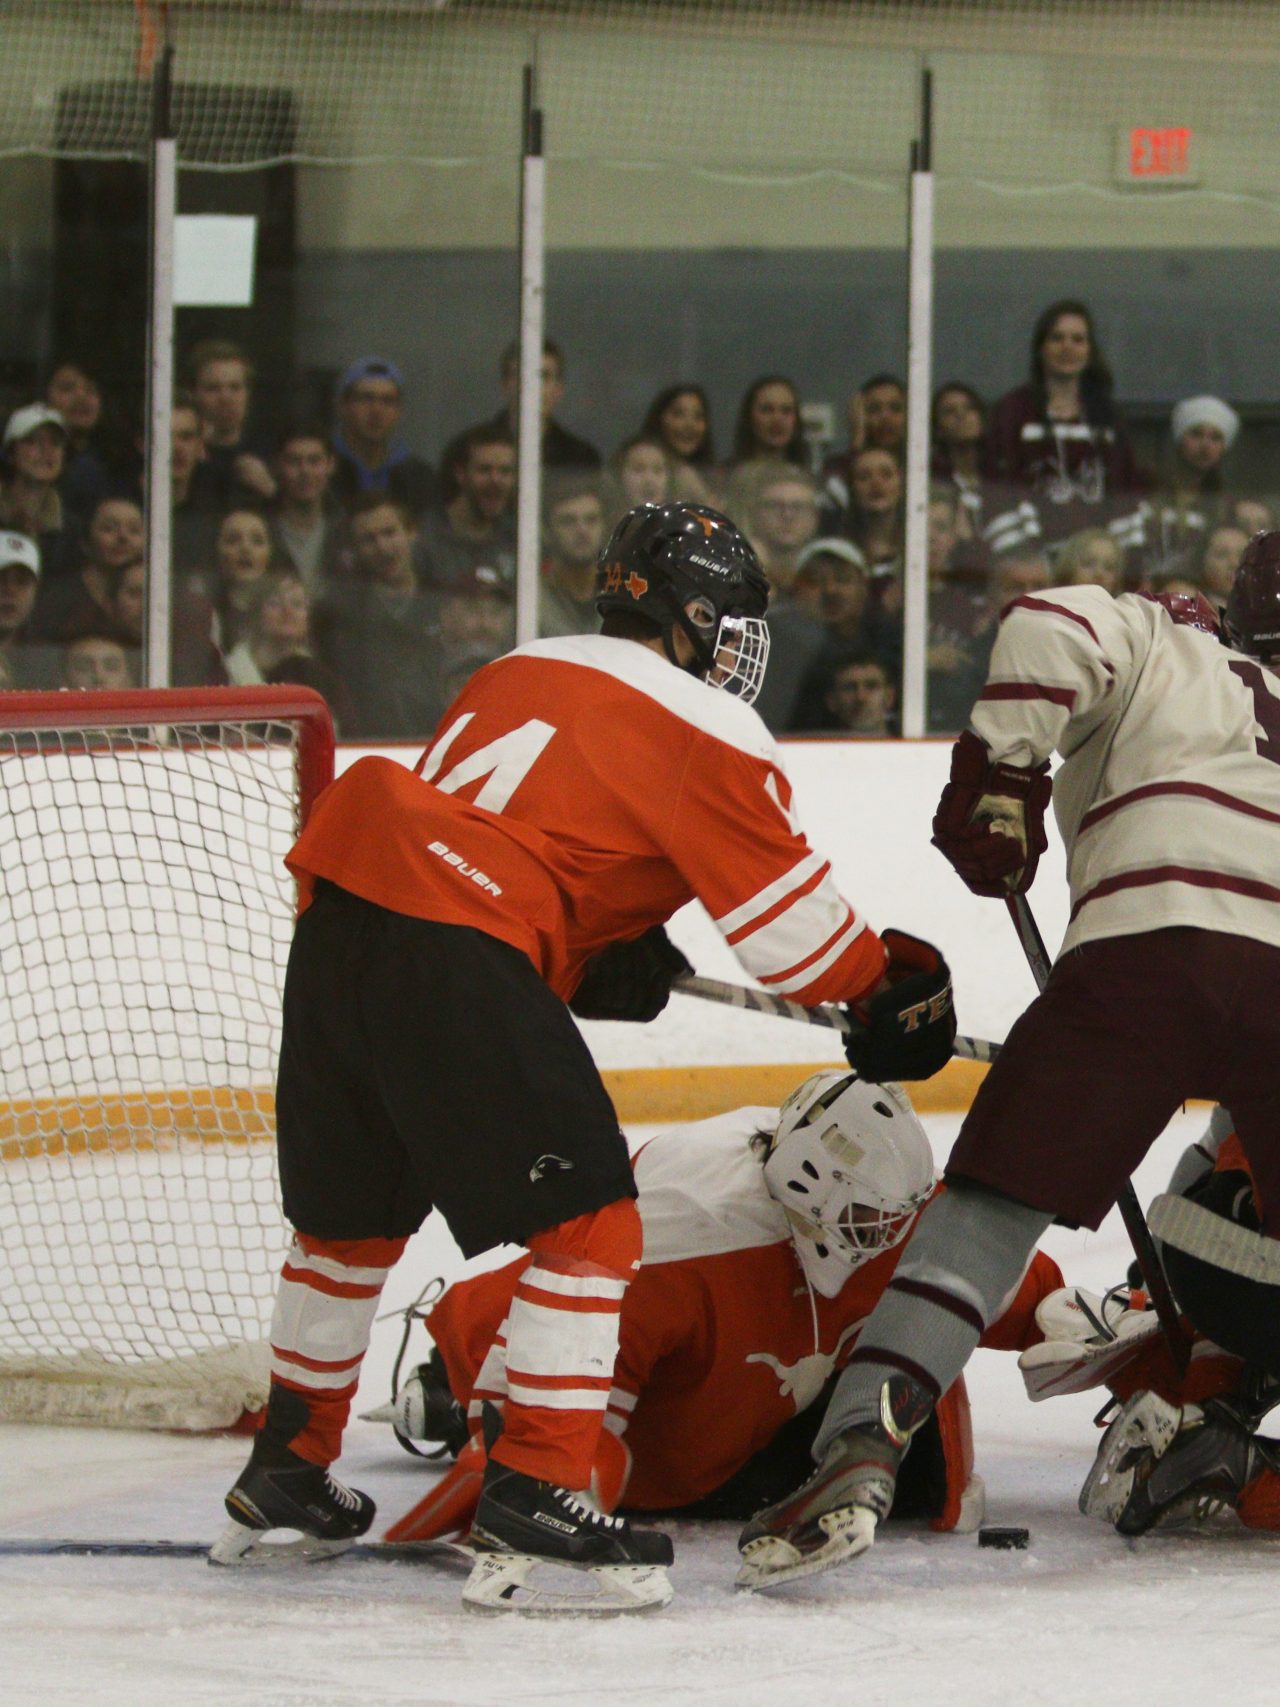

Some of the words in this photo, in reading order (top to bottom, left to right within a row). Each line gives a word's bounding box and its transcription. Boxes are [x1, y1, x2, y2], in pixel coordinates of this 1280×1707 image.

[1130, 127, 1190, 176] EXIT
[688, 554, 730, 576] BAUER
[427, 841, 503, 897] BAUER
[536, 1513, 575, 1533] BAUER
